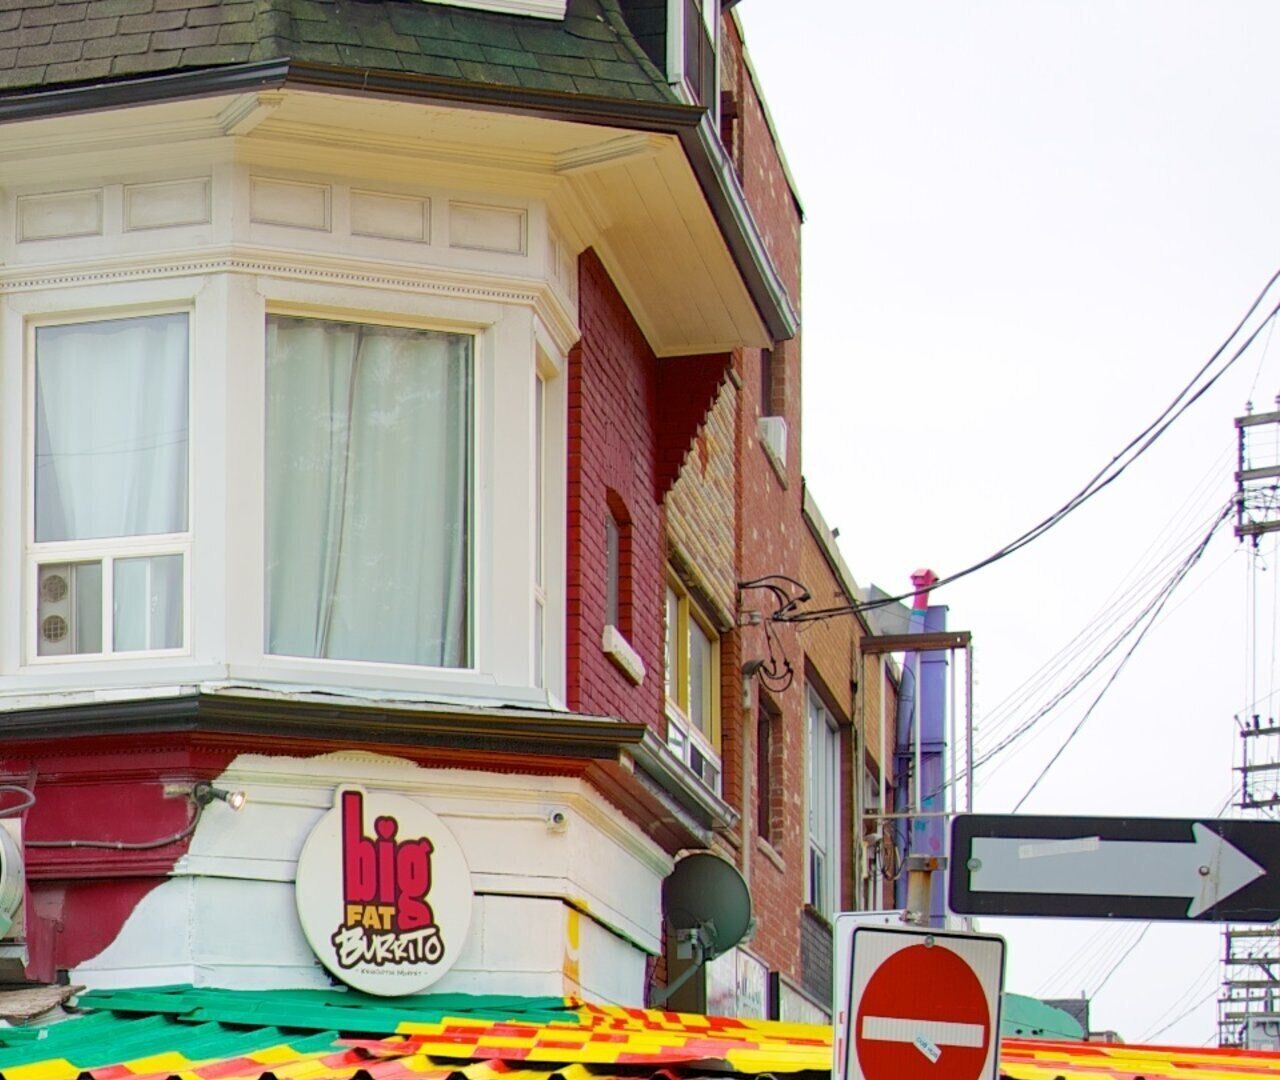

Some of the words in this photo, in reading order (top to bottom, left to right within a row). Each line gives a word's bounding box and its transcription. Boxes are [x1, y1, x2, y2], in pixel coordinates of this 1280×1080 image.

[342, 791, 434, 930] big
[347, 904, 396, 930] FAT
[333, 925, 444, 968] BURRITO
